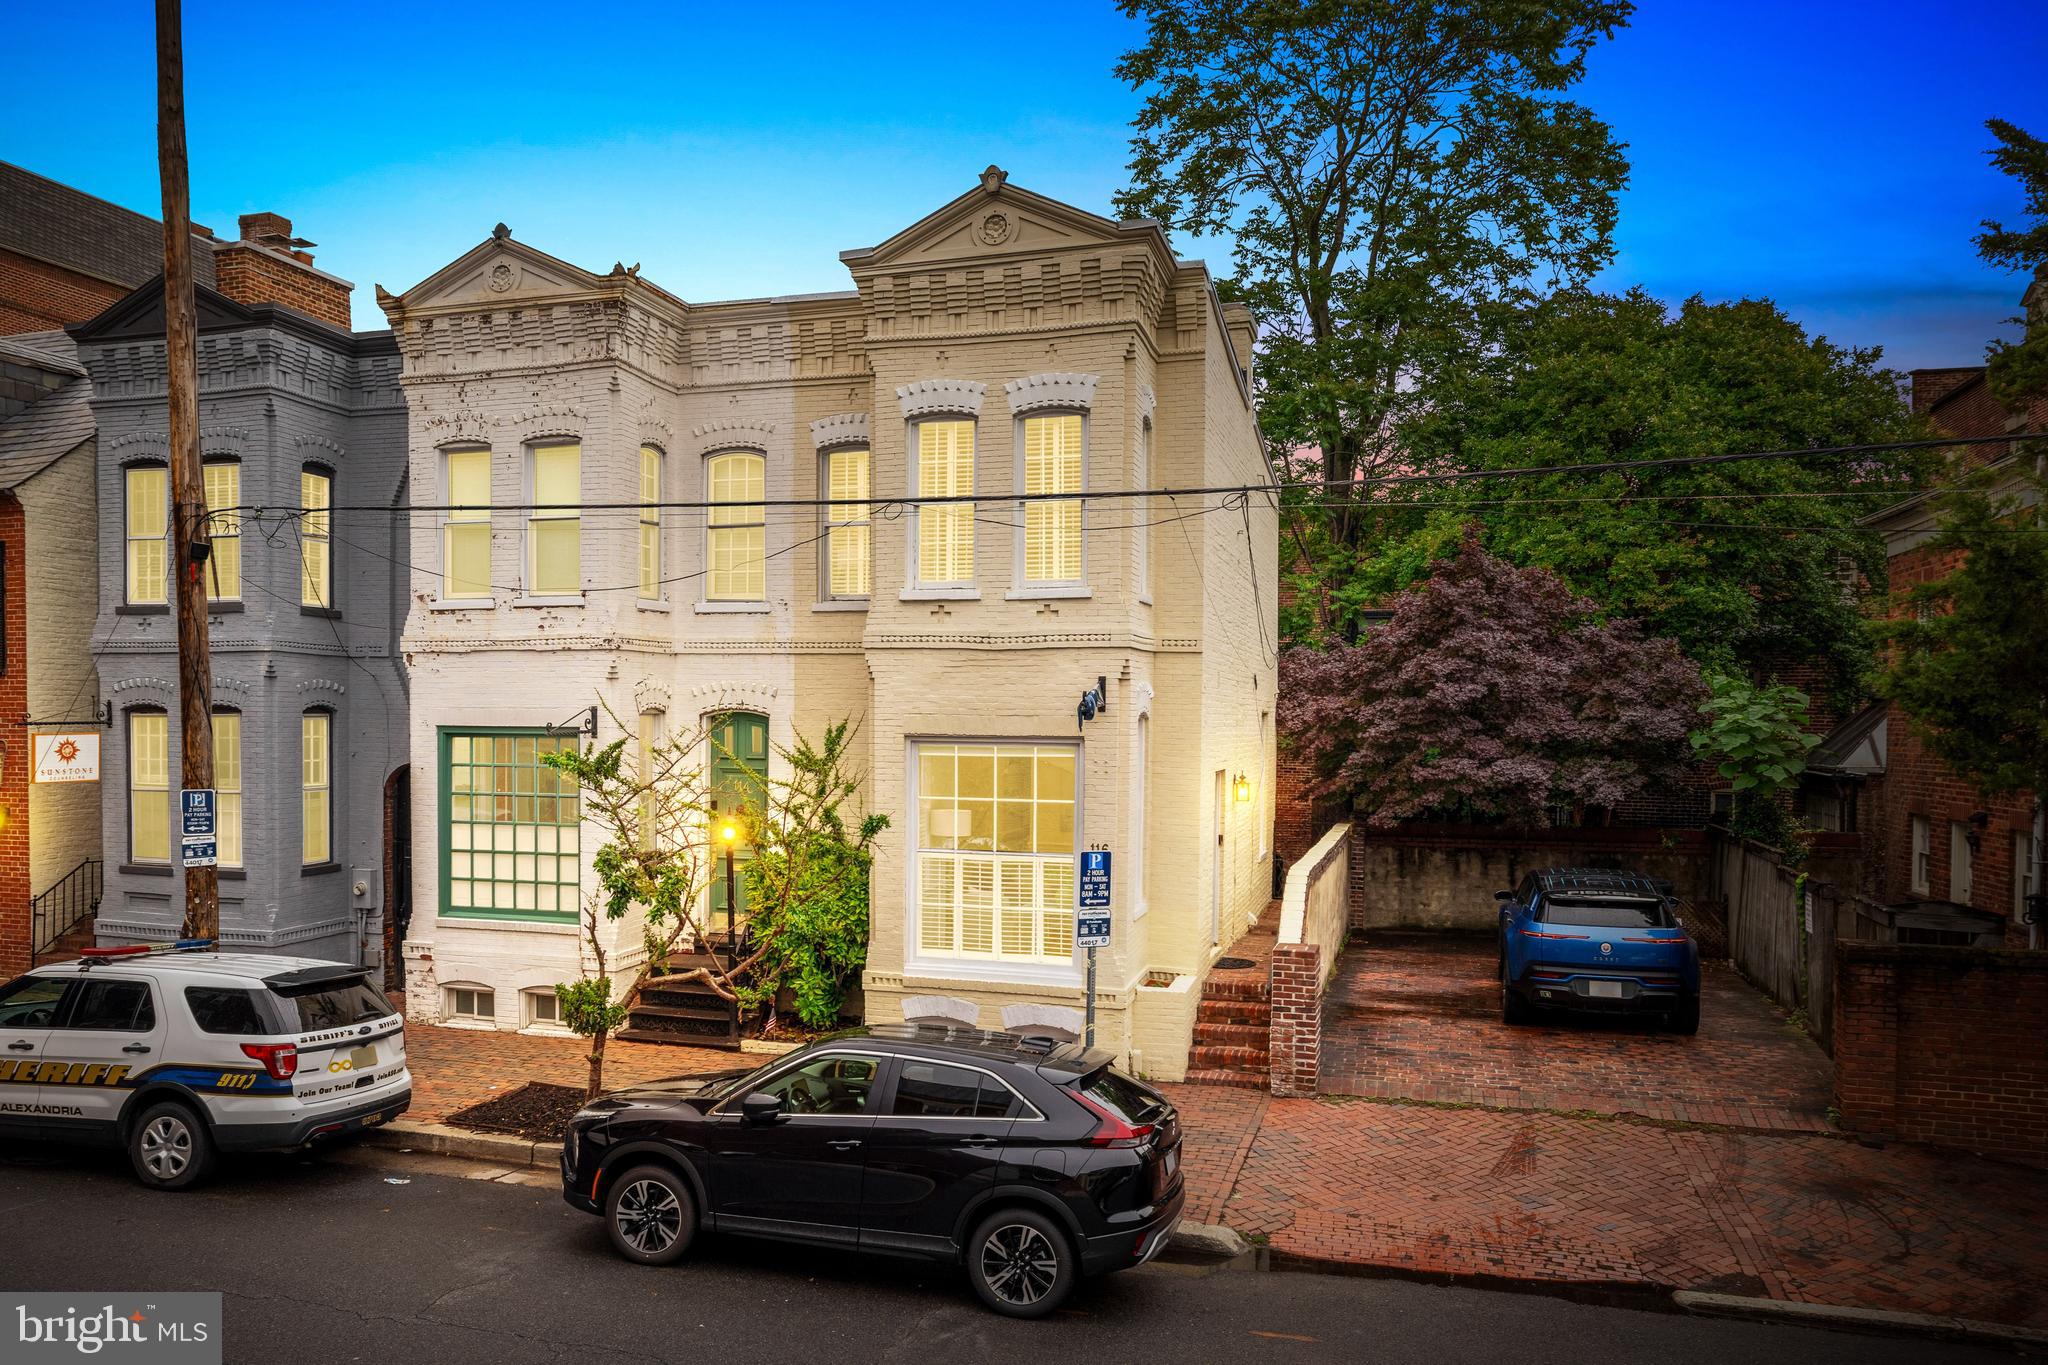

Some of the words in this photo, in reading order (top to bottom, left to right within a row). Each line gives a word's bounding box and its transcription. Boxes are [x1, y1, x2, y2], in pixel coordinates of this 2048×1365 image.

[41, 767, 93, 775] SUNSTONE
[193, 793, 203, 806] P
[1091, 853, 1102, 869] P
[1081, 890, 1093, 898] 8AM
[1567, 890, 1639, 898] FISKER
[300, 1029, 354, 1043] SHERIFF'S
[378, 1018, 399, 1029] OFFICE
[216, 1073, 248, 1088] 911
[298, 1089, 316, 1098] Join
[319, 1087, 333, 1095] Our
[334, 1081, 354, 1092] Team!
[0, 1103, 83, 1116] ALEXANDRIA
